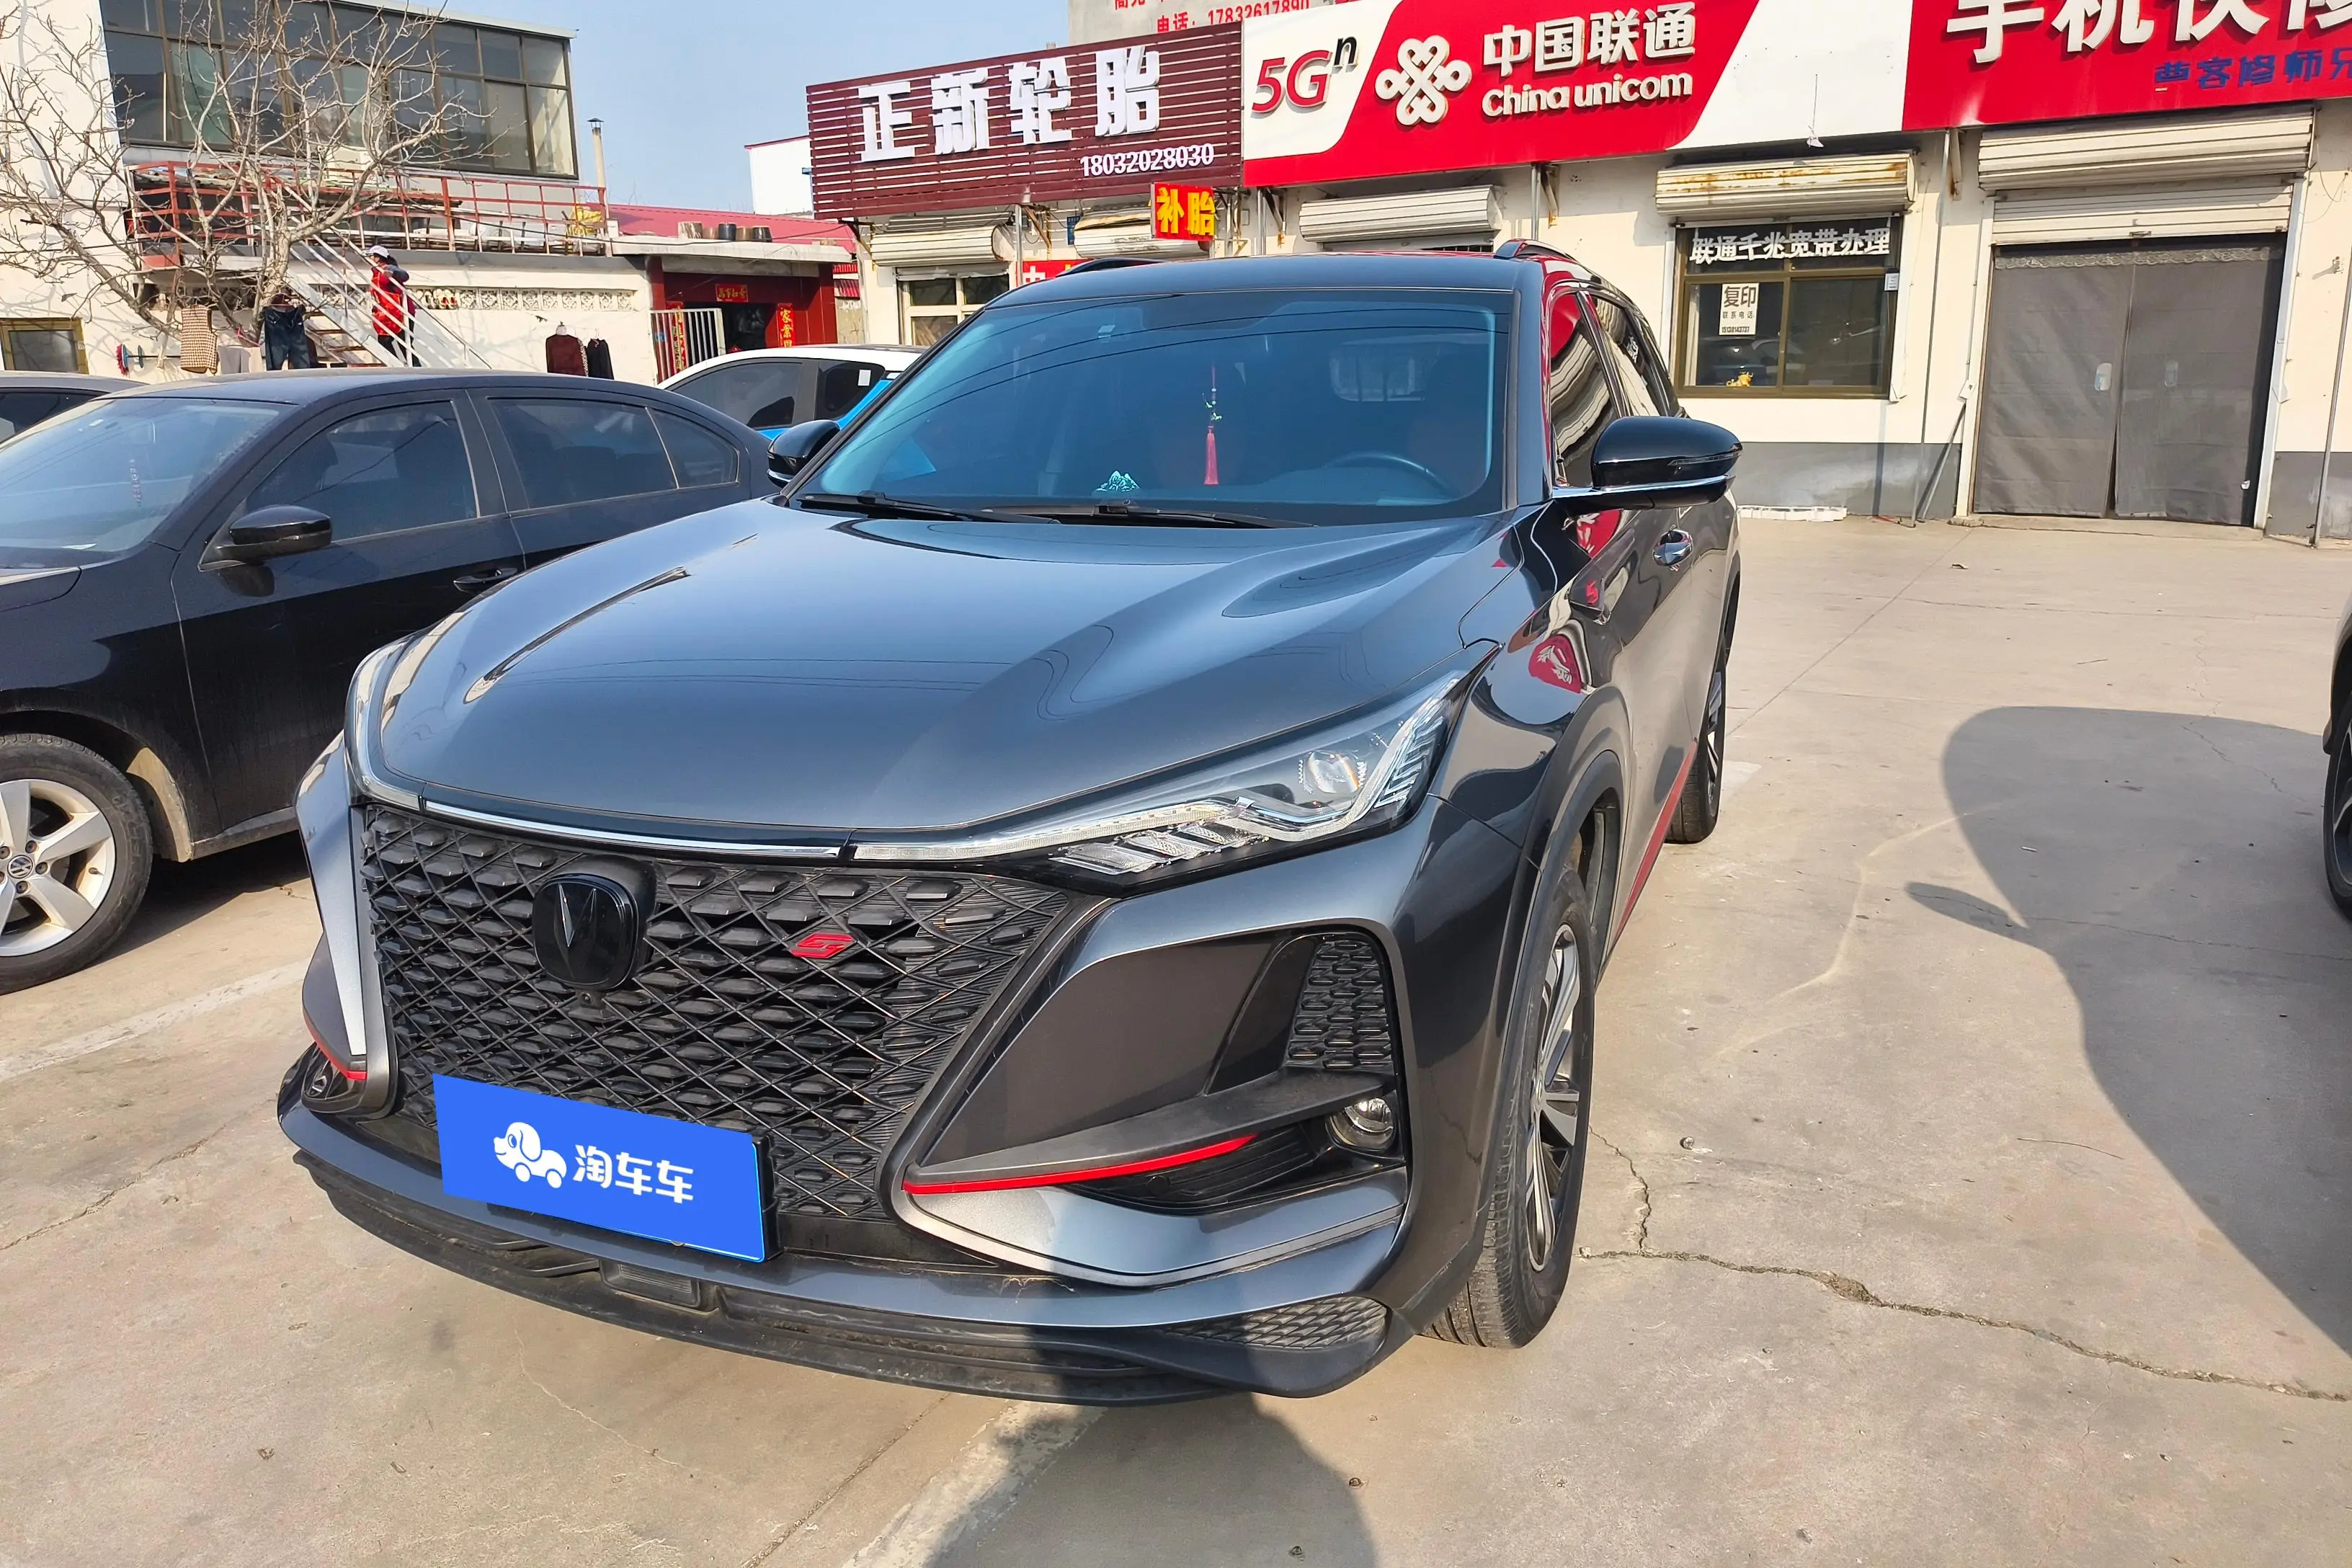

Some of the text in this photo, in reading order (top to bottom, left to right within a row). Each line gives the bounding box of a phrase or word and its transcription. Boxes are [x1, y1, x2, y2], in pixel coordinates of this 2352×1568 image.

[1483, 1, 1696, 77] 中国联通
[857, 45, 1162, 163] 正新轮胎
[1482, 71, 1693, 118] China unicom
[1079, 142, 1216, 178] 18032028030
[1155, 184, 1217, 237] 补胎
[1689, 227, 1891, 265] 联通千兆宽带办理
[1724, 286, 1756, 308] 复印
